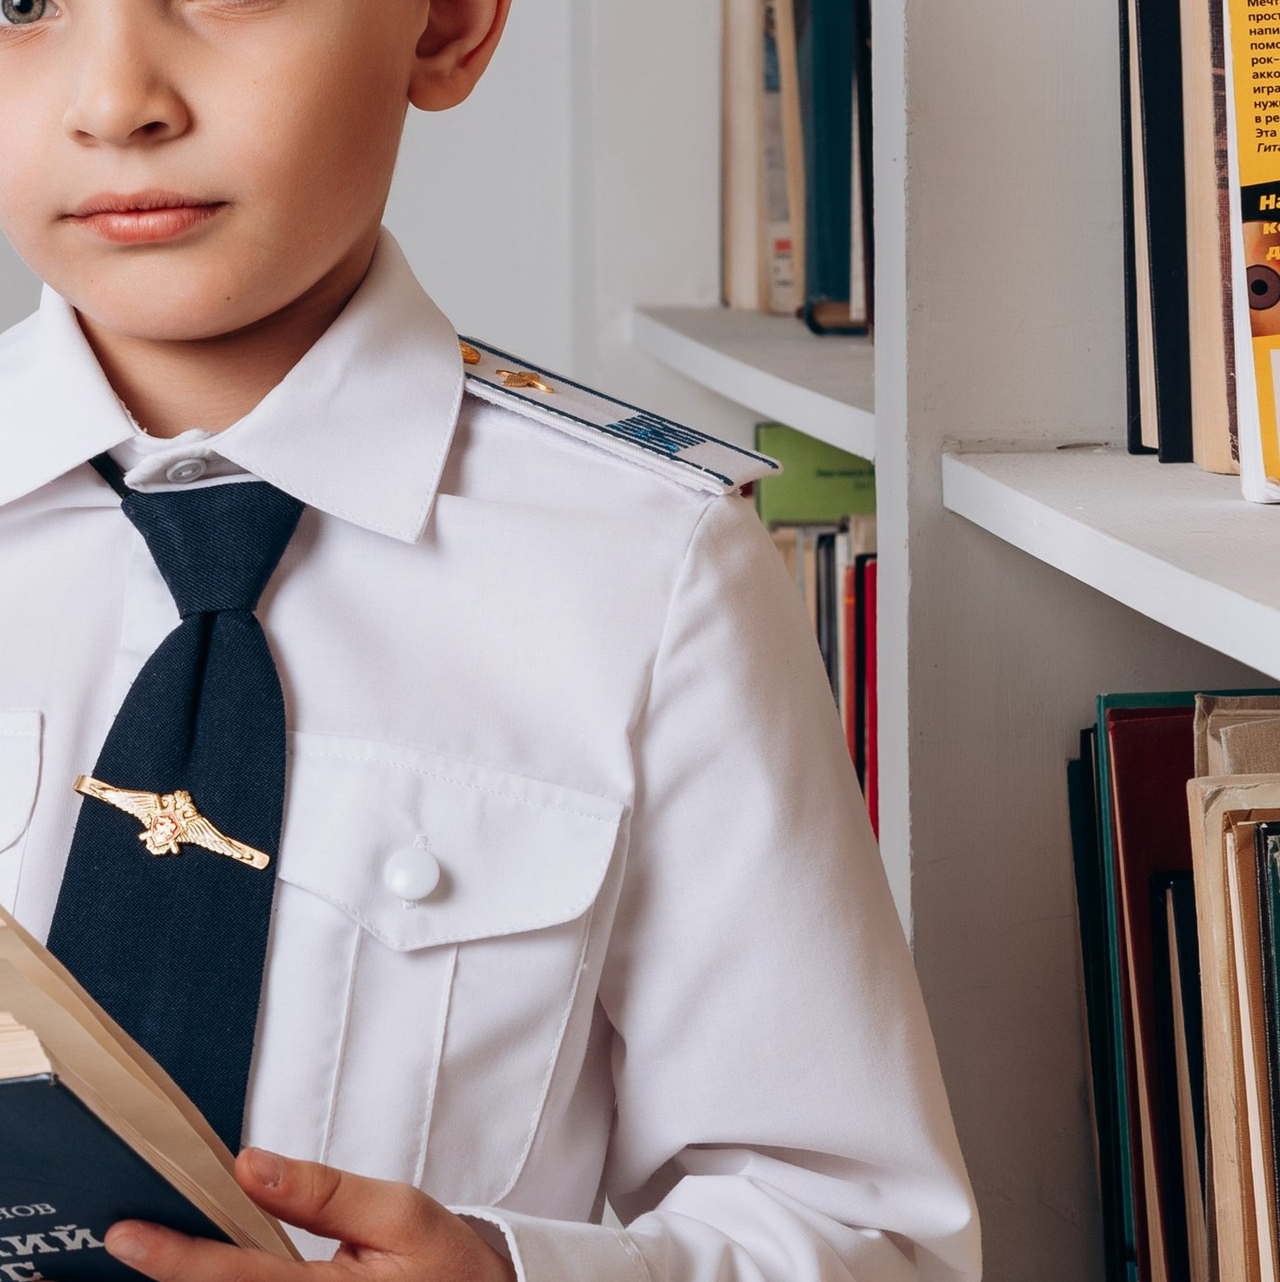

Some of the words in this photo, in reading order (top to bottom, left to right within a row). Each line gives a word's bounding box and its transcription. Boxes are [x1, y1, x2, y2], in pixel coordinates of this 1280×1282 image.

[1248, 12, 1280, 23] прос
[1249, 27, 1280, 36] напи
[1252, 70, 1280, 79] акко
[1253, 85, 1280, 96] игра
[1254, 100, 1280, 111] нуж
[1255, 115, 1262, 124] в
[1265, 114, 1280, 125] ре
[1255, 128, 1277, 138] Эта
